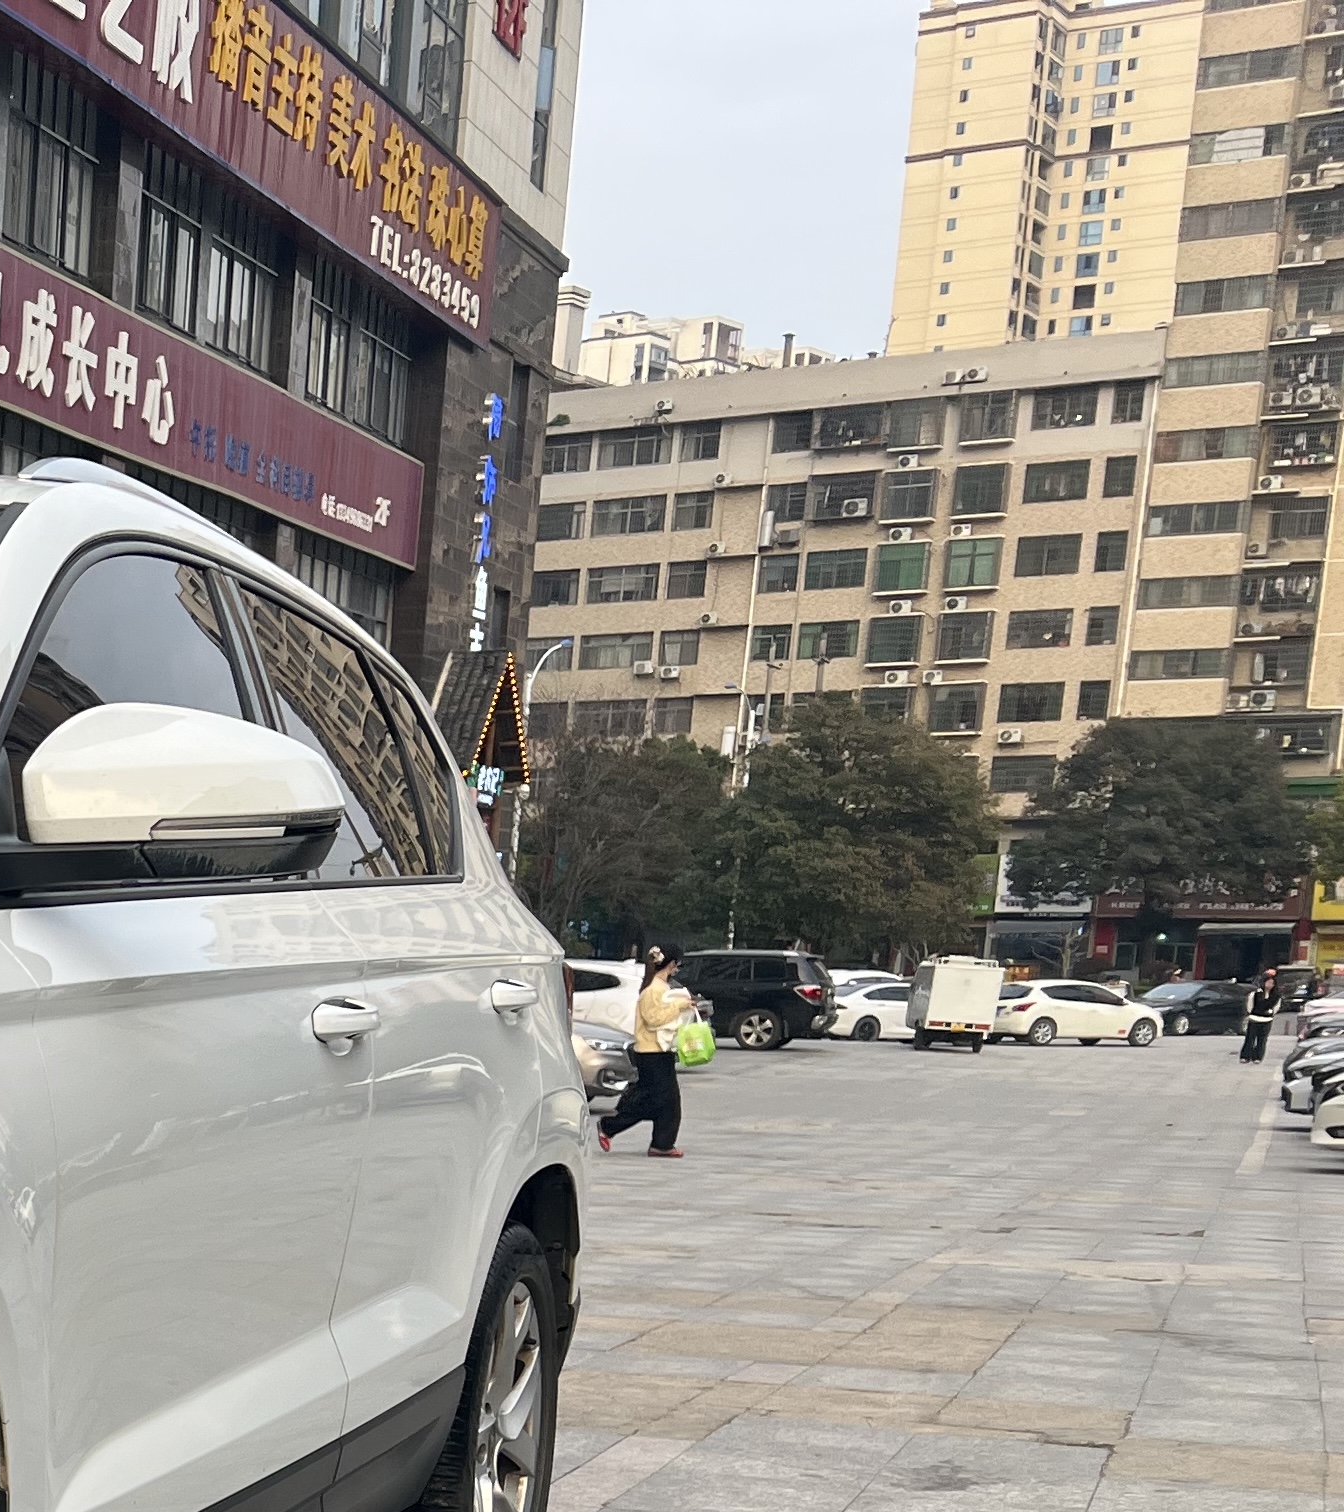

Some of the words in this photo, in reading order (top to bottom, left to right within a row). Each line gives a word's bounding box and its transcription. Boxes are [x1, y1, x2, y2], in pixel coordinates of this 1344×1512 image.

[326, 74, 376, 191] 美术
[379, 122, 426, 234] 书法
[425, 164, 489, 282] 珠心算
[370, 214, 481, 330] TEL:8283459
